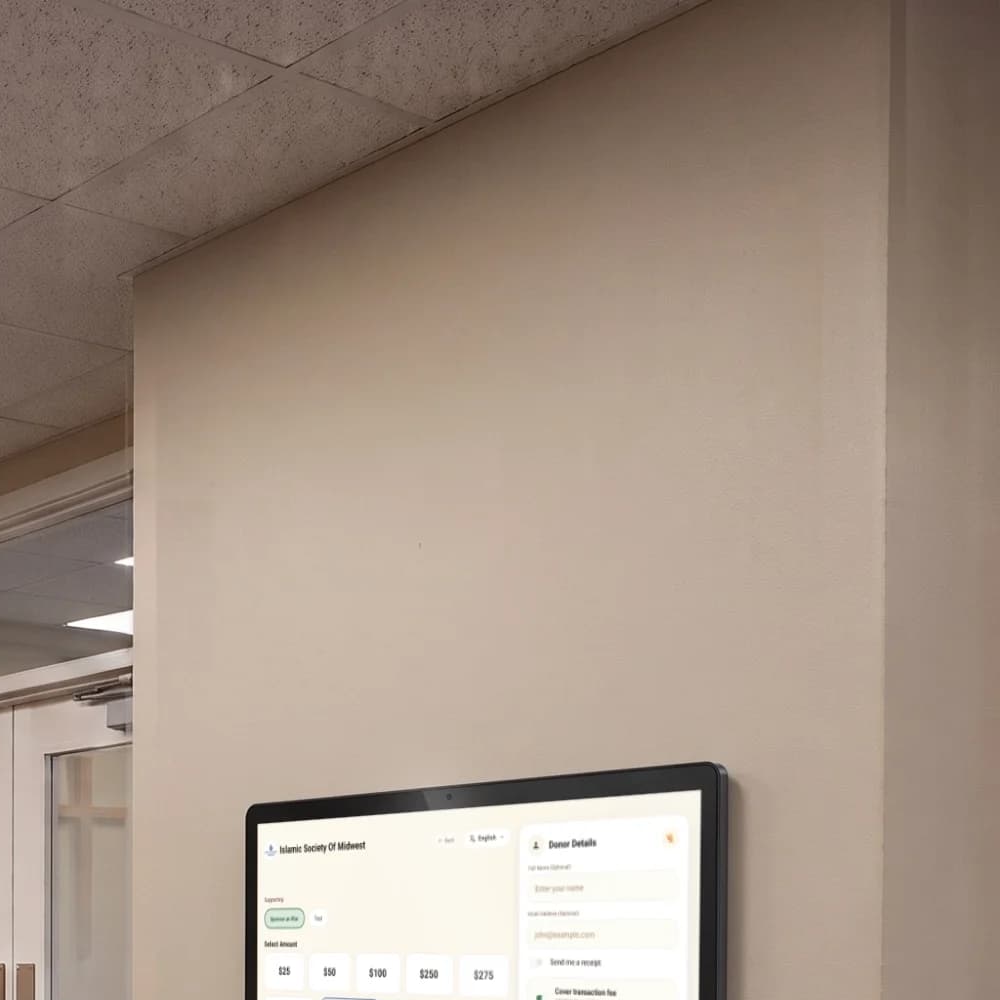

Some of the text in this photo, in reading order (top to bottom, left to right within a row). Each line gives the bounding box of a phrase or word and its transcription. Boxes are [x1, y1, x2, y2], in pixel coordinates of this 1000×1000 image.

[280, 841, 366, 854] Islamic Society Of Midwest
[549, 838, 597, 849] Donor Details
[535, 884, 550, 893] Enter
[550, 957, 565, 966] Send
[581, 958, 602, 967] receipt
[278, 966, 291, 976] $25
[323, 966, 336, 977] $50
[369, 968, 387, 978] $100
[420, 968, 439, 979] $250
[474, 969, 494, 980] $275
[555, 987, 617, 997] Cover transaction fee
